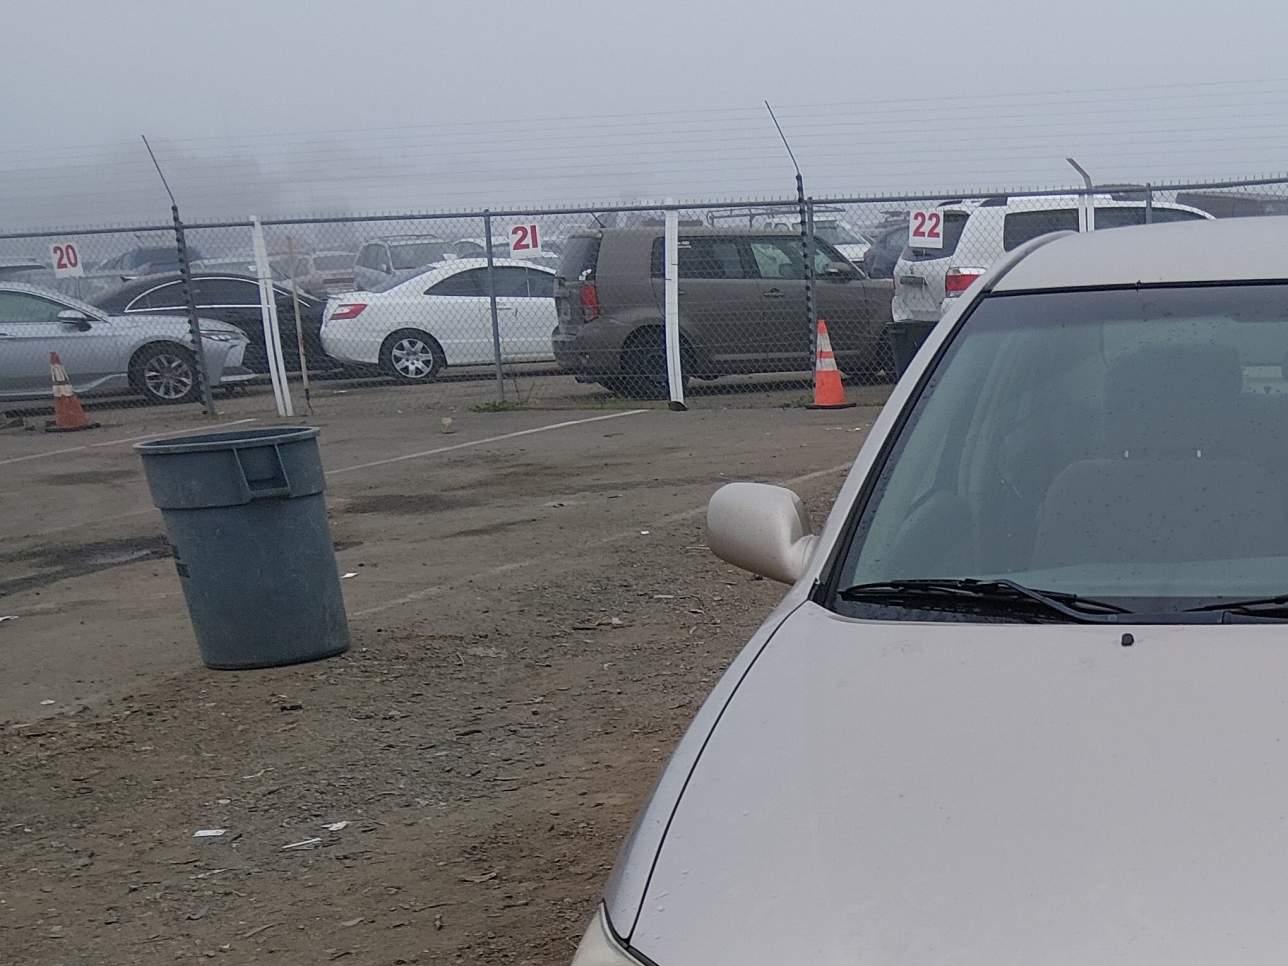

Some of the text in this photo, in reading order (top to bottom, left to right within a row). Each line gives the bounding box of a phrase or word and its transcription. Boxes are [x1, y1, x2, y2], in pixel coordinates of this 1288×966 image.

[512, 225, 538, 250] 21
[912, 212, 940, 238] 22
[53, 245, 77, 269] 20
